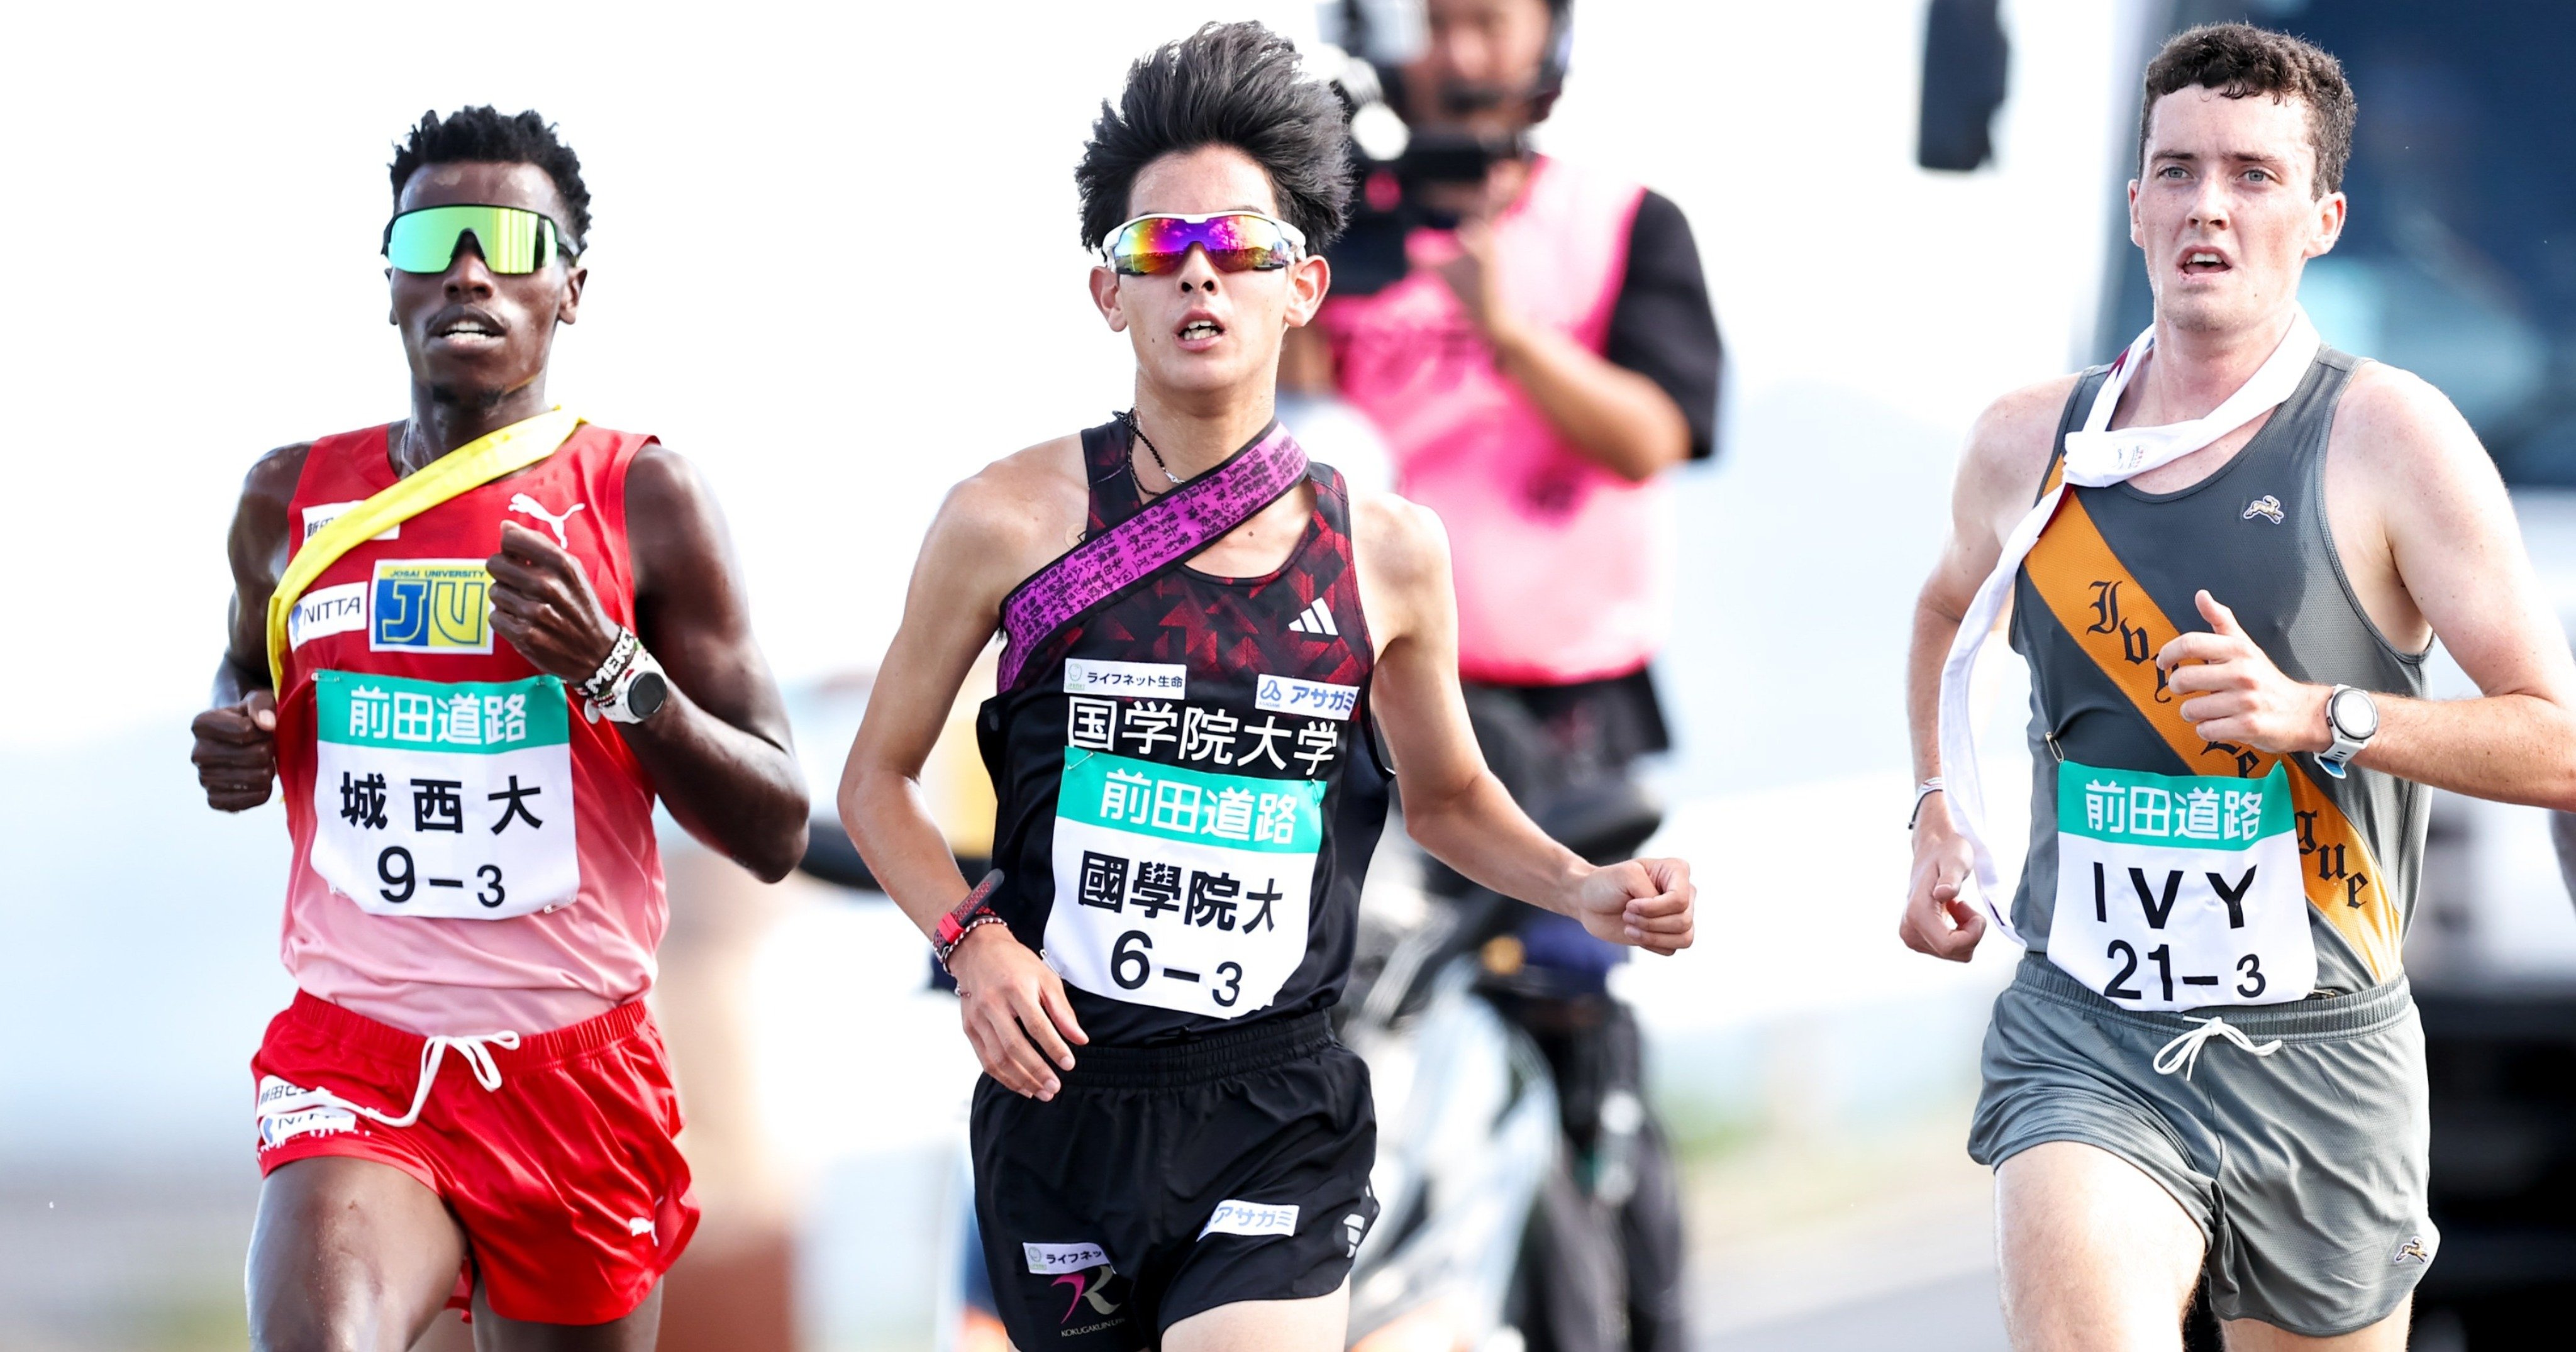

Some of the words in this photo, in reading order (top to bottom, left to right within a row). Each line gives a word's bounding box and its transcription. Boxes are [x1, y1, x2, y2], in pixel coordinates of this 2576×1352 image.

[304, 596, 360, 626] NITTA
[382, 581, 485, 645] JU
[1087, 672, 1183, 688] ライフネット生命
[1291, 685, 1355, 711] アサガミ
[349, 685, 527, 745] 前田道路
[1069, 696, 1338, 776] 国学院大学
[340, 771, 543, 836] 城西大
[1100, 768, 1298, 845] 前田道路
[2085, 779, 2262, 841] 前田道路
[1078, 850, 1283, 934] 國學院大
[2093, 862, 2258, 929] IVY
[1214, 1207, 1292, 1227] アサガミ
[1061, 1321, 1111, 1337] KOKUGAKUIN
